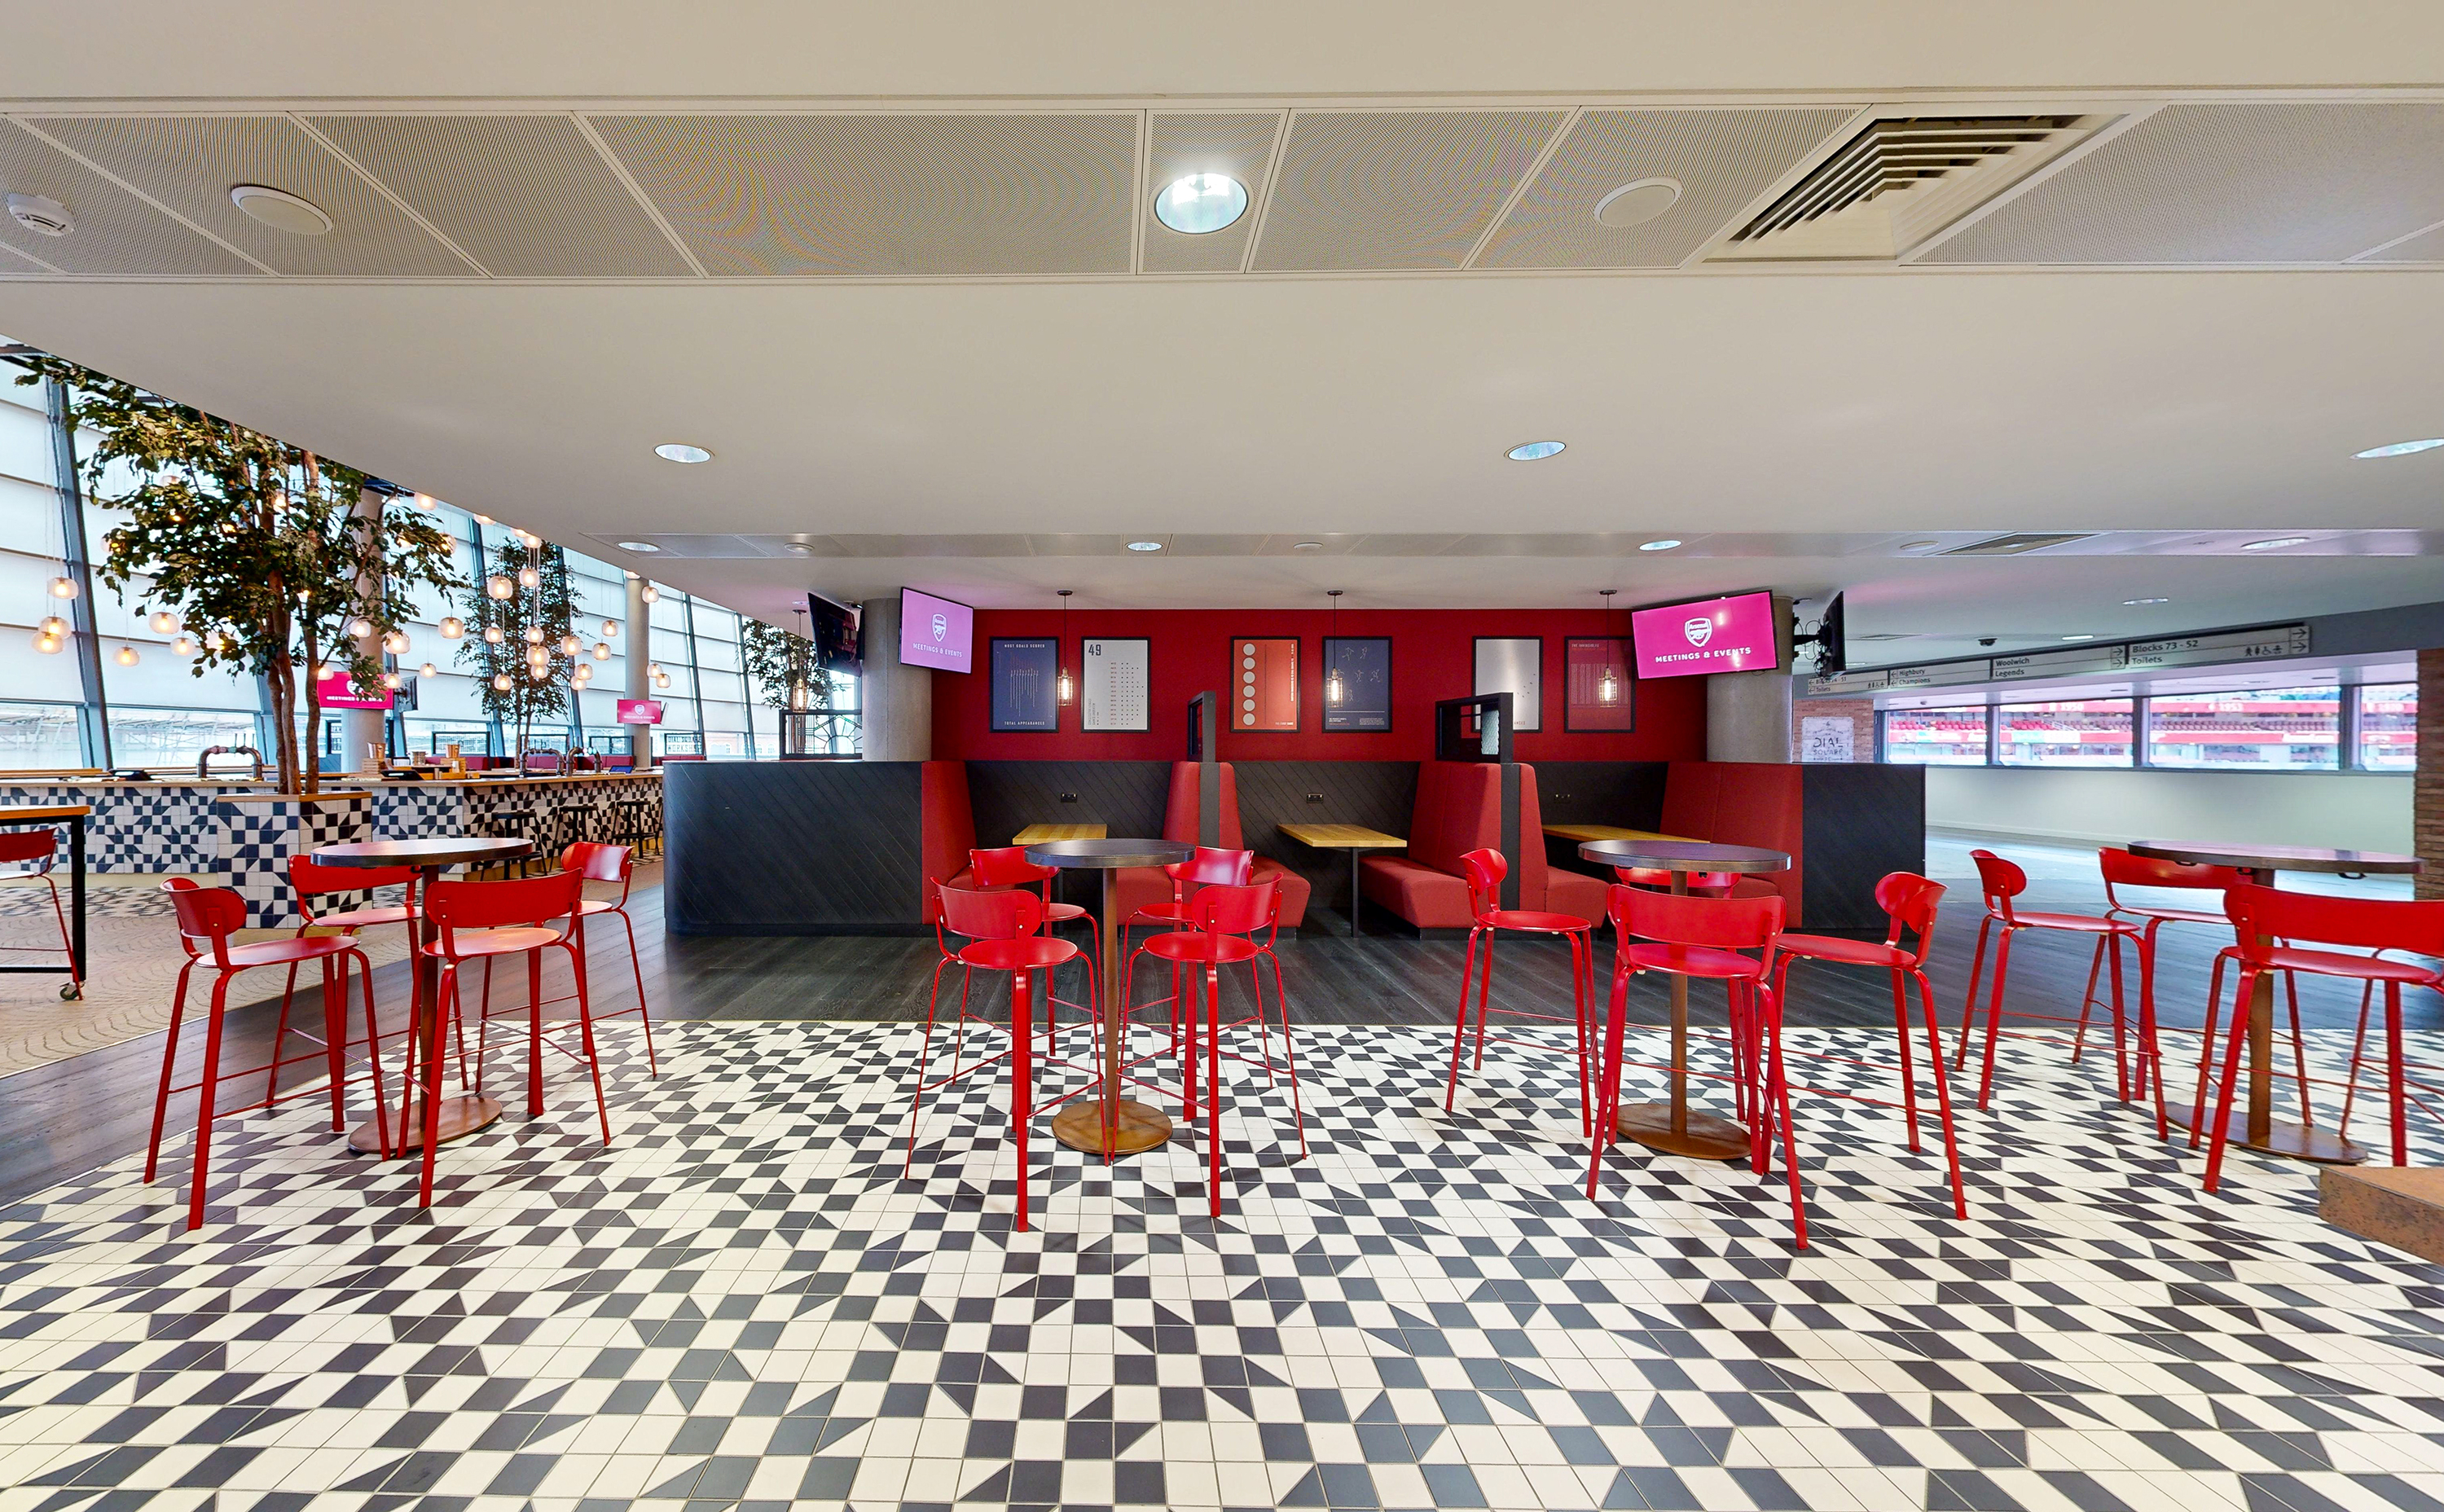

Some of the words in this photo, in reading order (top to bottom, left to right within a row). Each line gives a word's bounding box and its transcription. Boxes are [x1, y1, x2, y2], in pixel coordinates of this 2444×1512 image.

[912, 643, 938, 653] MEETINGS
[945, 648, 963, 657] EVENTS
[1088, 644, 1101, 656] 49
[2133, 644, 2163, 653] Blocks
[2166, 642, 2178, 650] 73
[1655, 653, 1700, 662] MEETINGS
[1714, 647, 1752, 657] EVENTS
[1996, 657, 2030, 666] Woolwich
[1995, 669, 2025, 677] Legends
[1813, 736, 1844, 748] DIAL
